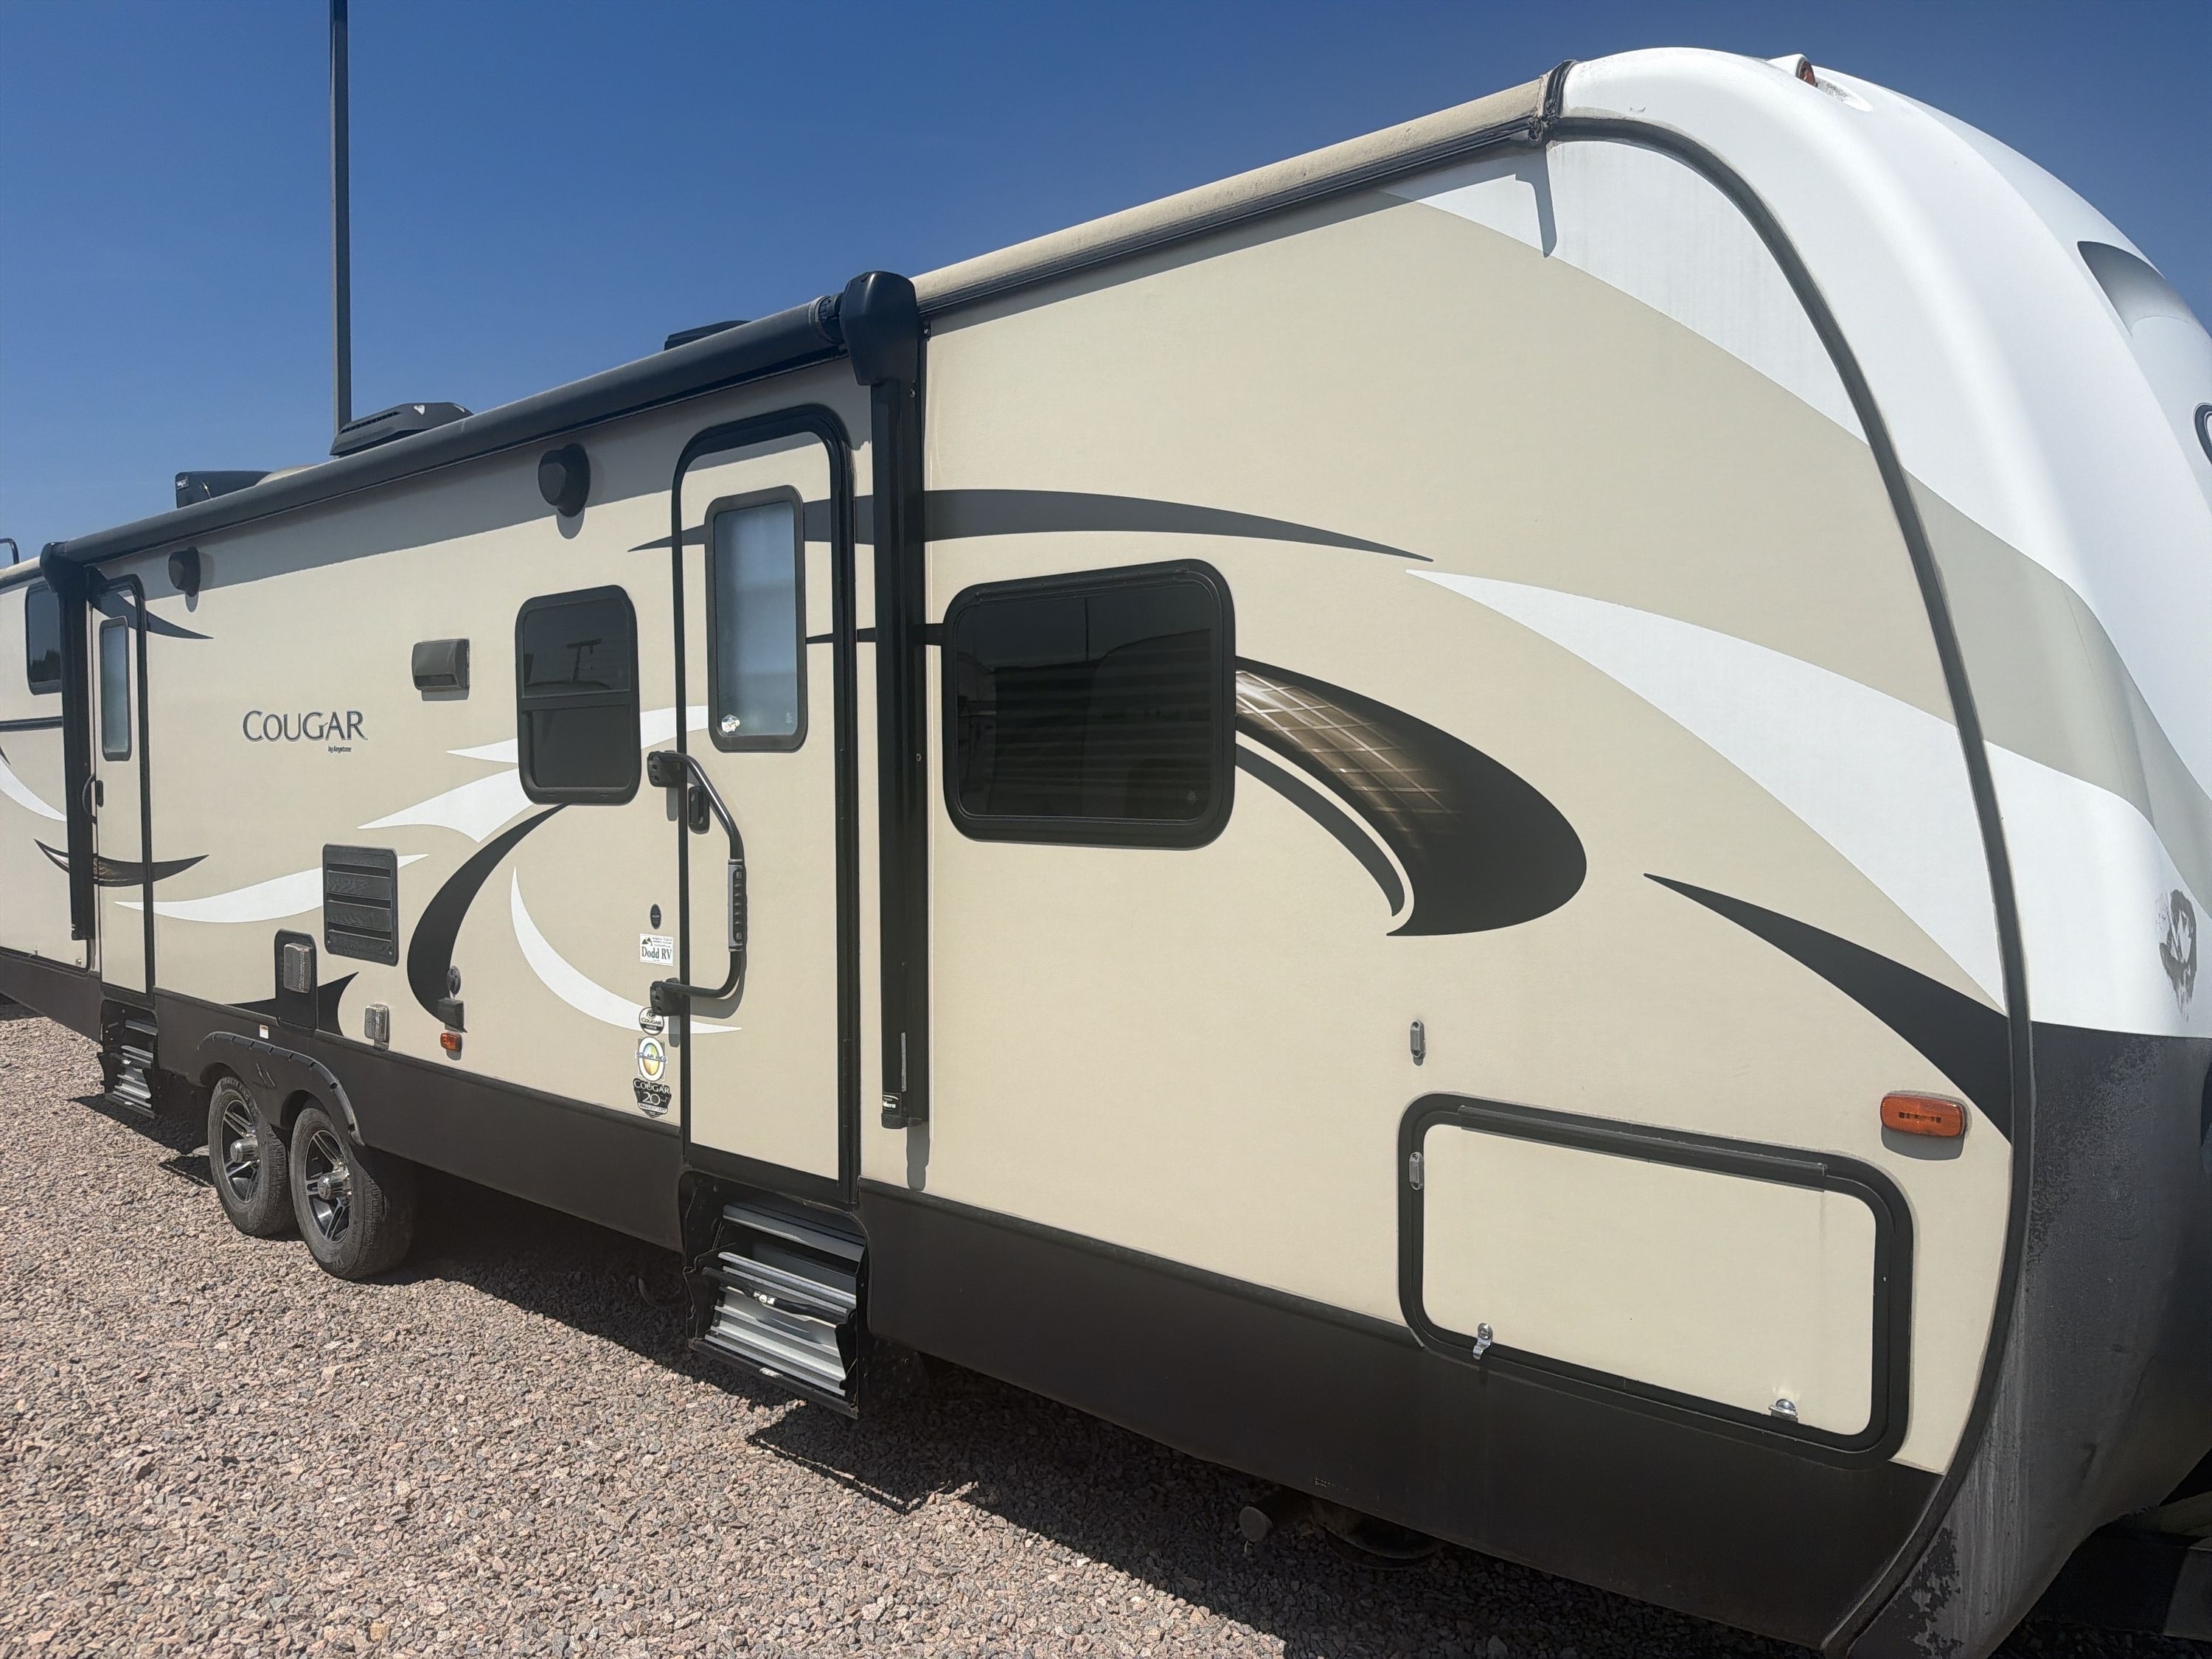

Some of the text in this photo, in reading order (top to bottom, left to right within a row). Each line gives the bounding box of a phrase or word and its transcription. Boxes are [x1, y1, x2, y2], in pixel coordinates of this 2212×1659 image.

[243, 710, 369, 742] COUGAR
[641, 946, 672, 960] Dodd RV
[633, 1079, 670, 1094] COUGAR
[642, 1091, 661, 1105] 20
